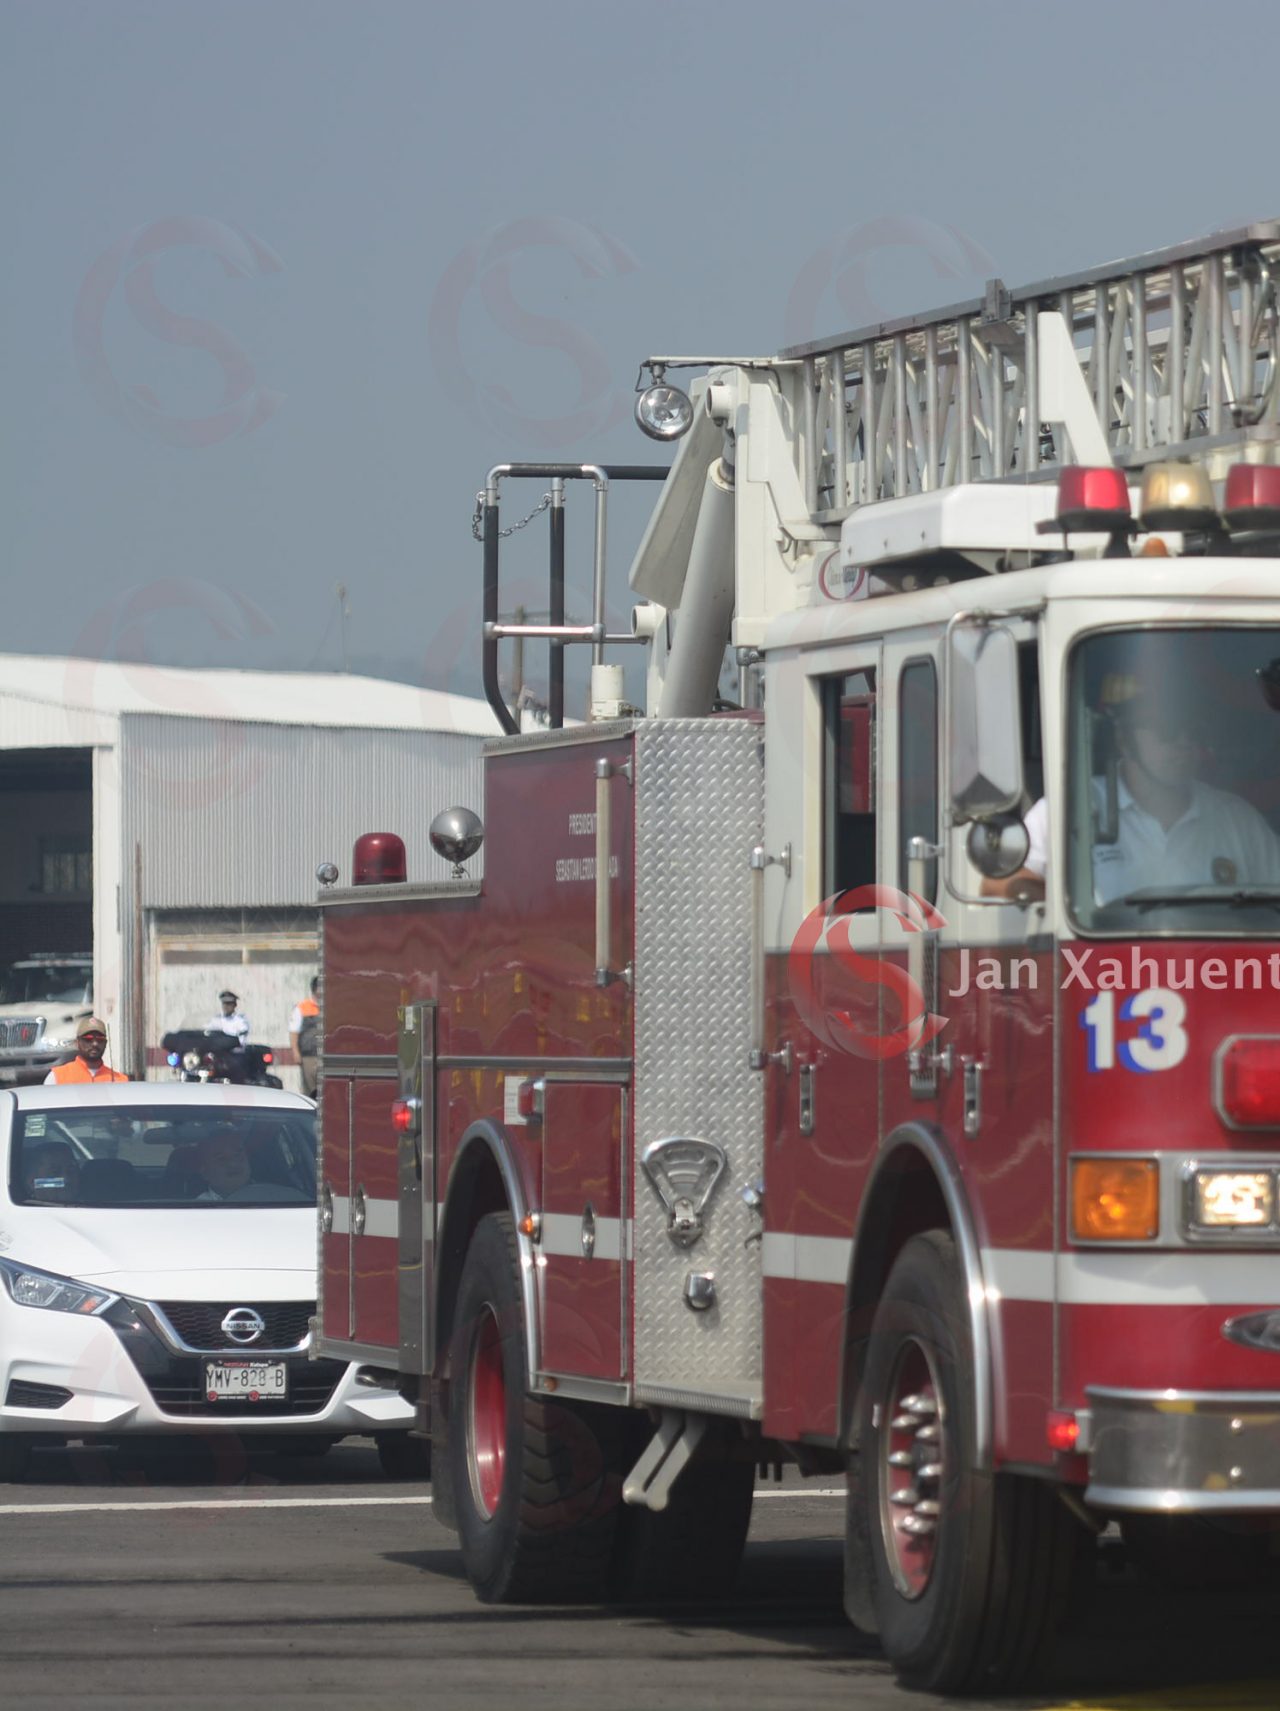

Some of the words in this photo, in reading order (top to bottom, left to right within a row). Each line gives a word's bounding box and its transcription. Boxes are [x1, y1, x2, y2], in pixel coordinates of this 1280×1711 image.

[568, 813, 597, 835] PRESIDENT
[1079, 988, 1189, 1075] 13
[226, 1322, 261, 1331] NISSAN
